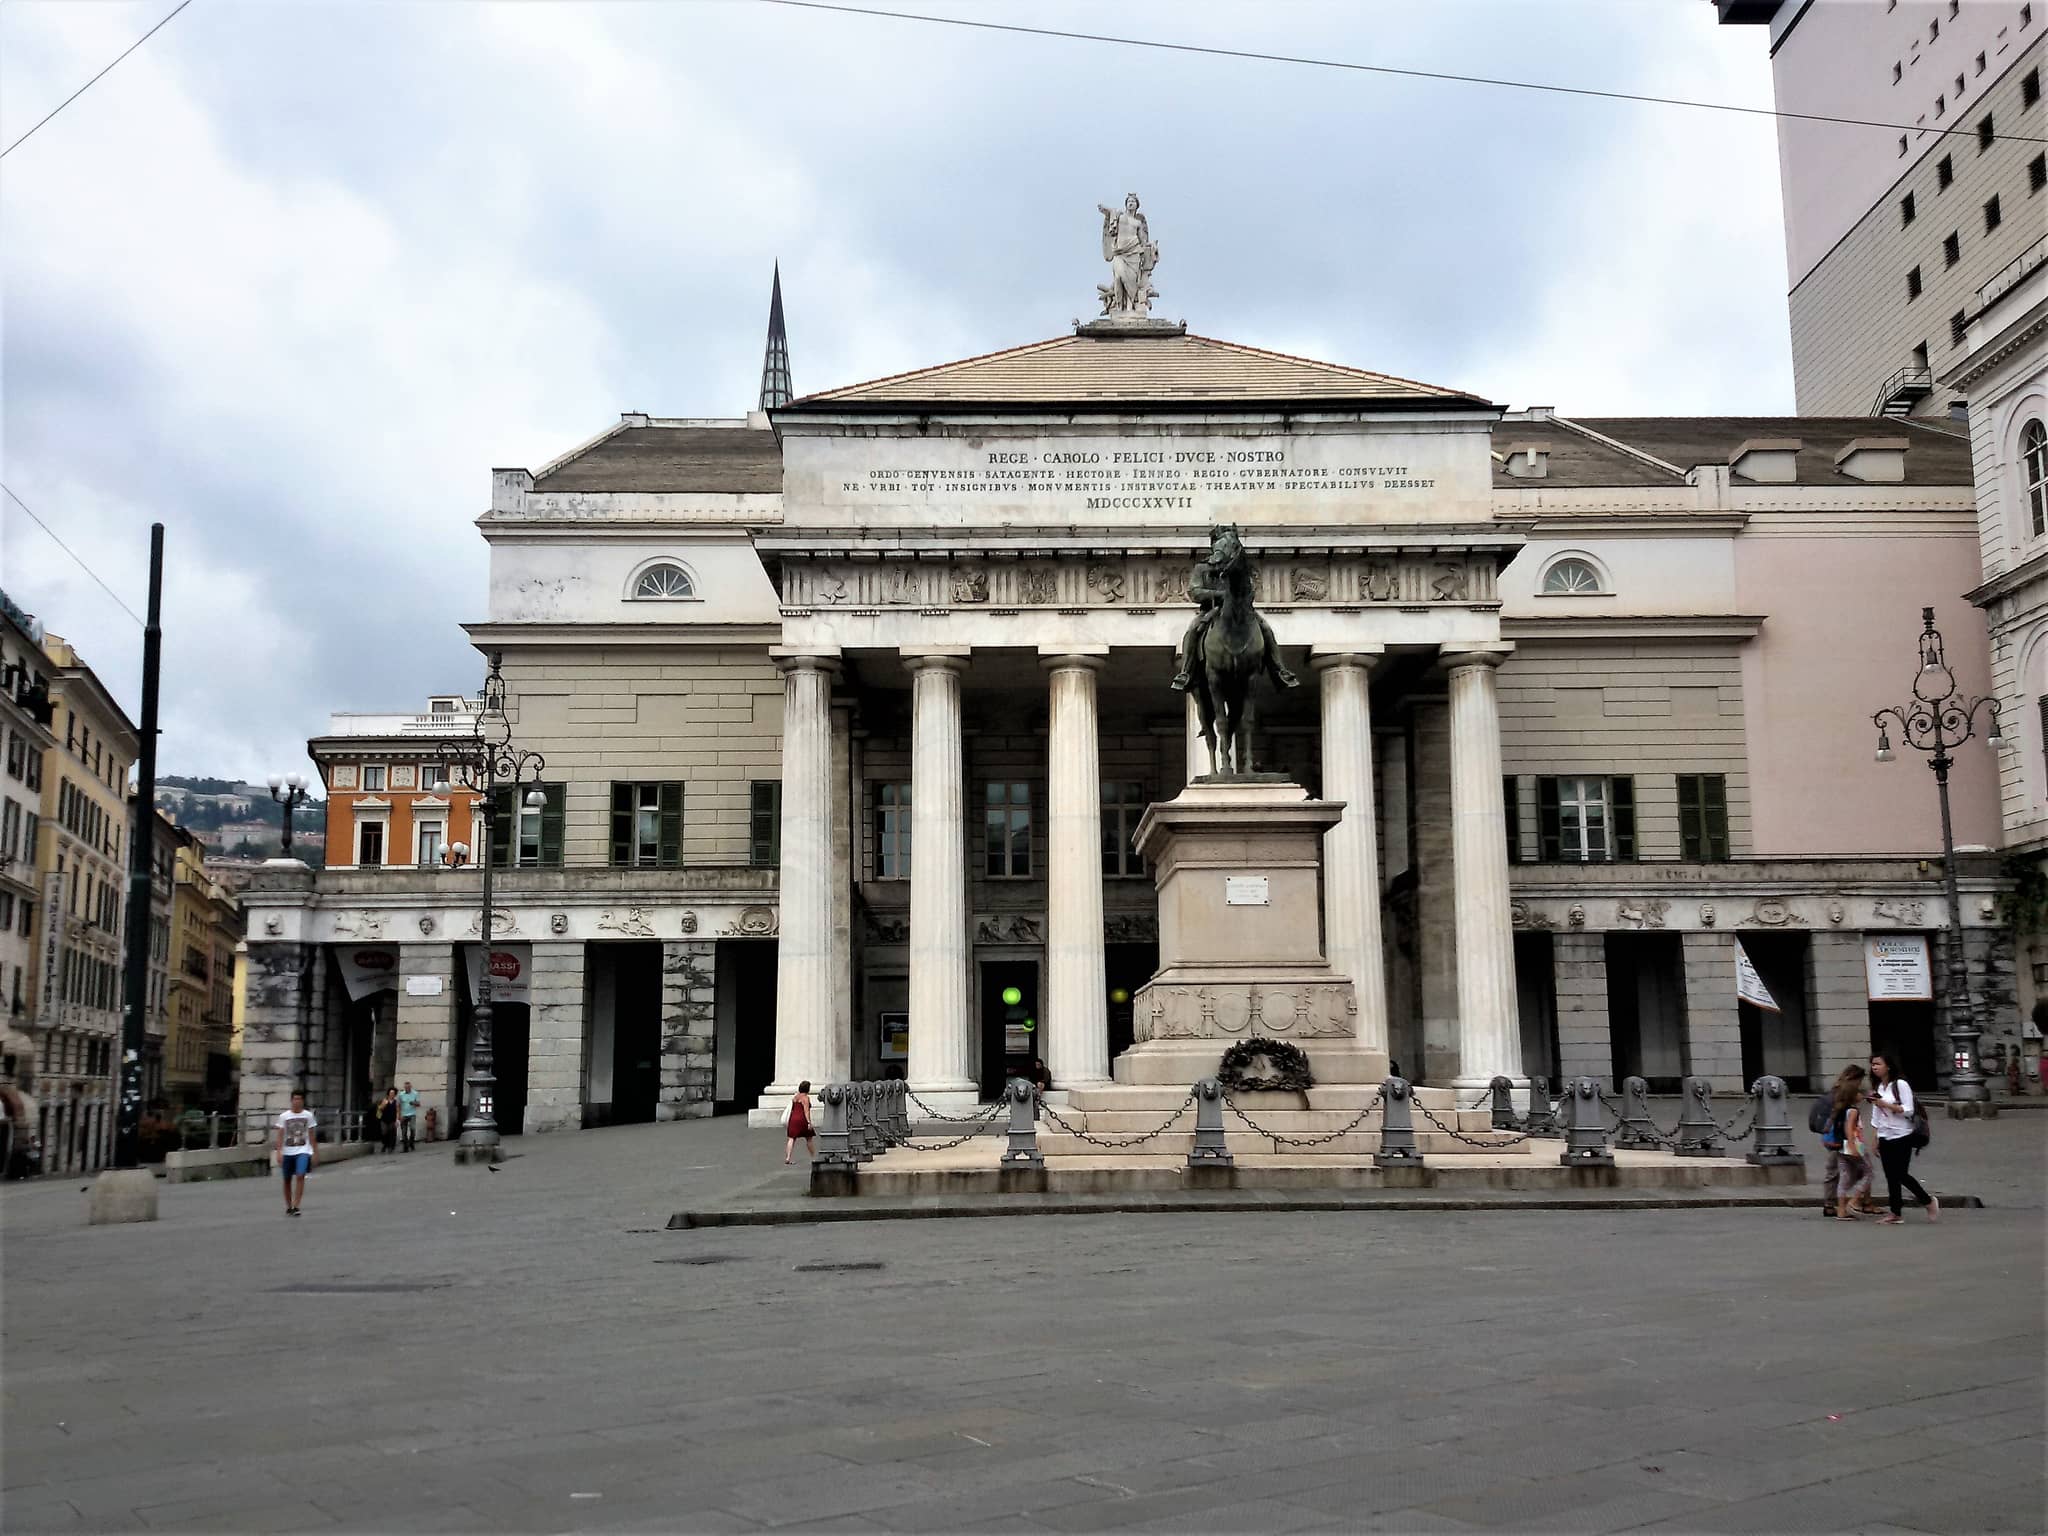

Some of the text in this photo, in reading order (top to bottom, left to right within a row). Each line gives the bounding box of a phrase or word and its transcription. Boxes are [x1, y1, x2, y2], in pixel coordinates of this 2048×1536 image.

[989, 451, 1285, 464] REGE CAROLO FELICI DVCE NOSTRO
[869, 471, 900, 479] ORDO
[907, 470, 976, 479] GENVENSIS
[985, 470, 1055, 479] SATAGENTE
[1066, 470, 1121, 479] HECTORE
[1193, 470, 1229, 478] REGIO
[1239, 468, 1329, 477] GVBERNATORE
[1338, 467, 1408, 476] CONSVLVIT
[843, 480, 1435, 491] NE VRBI TOT INSIGNIBVS MONVMENTIS INSTRVCTAE THEATRVM SPECTABILIVS DEESSET
[1087, 497, 1193, 509] MDCCCXXVII
